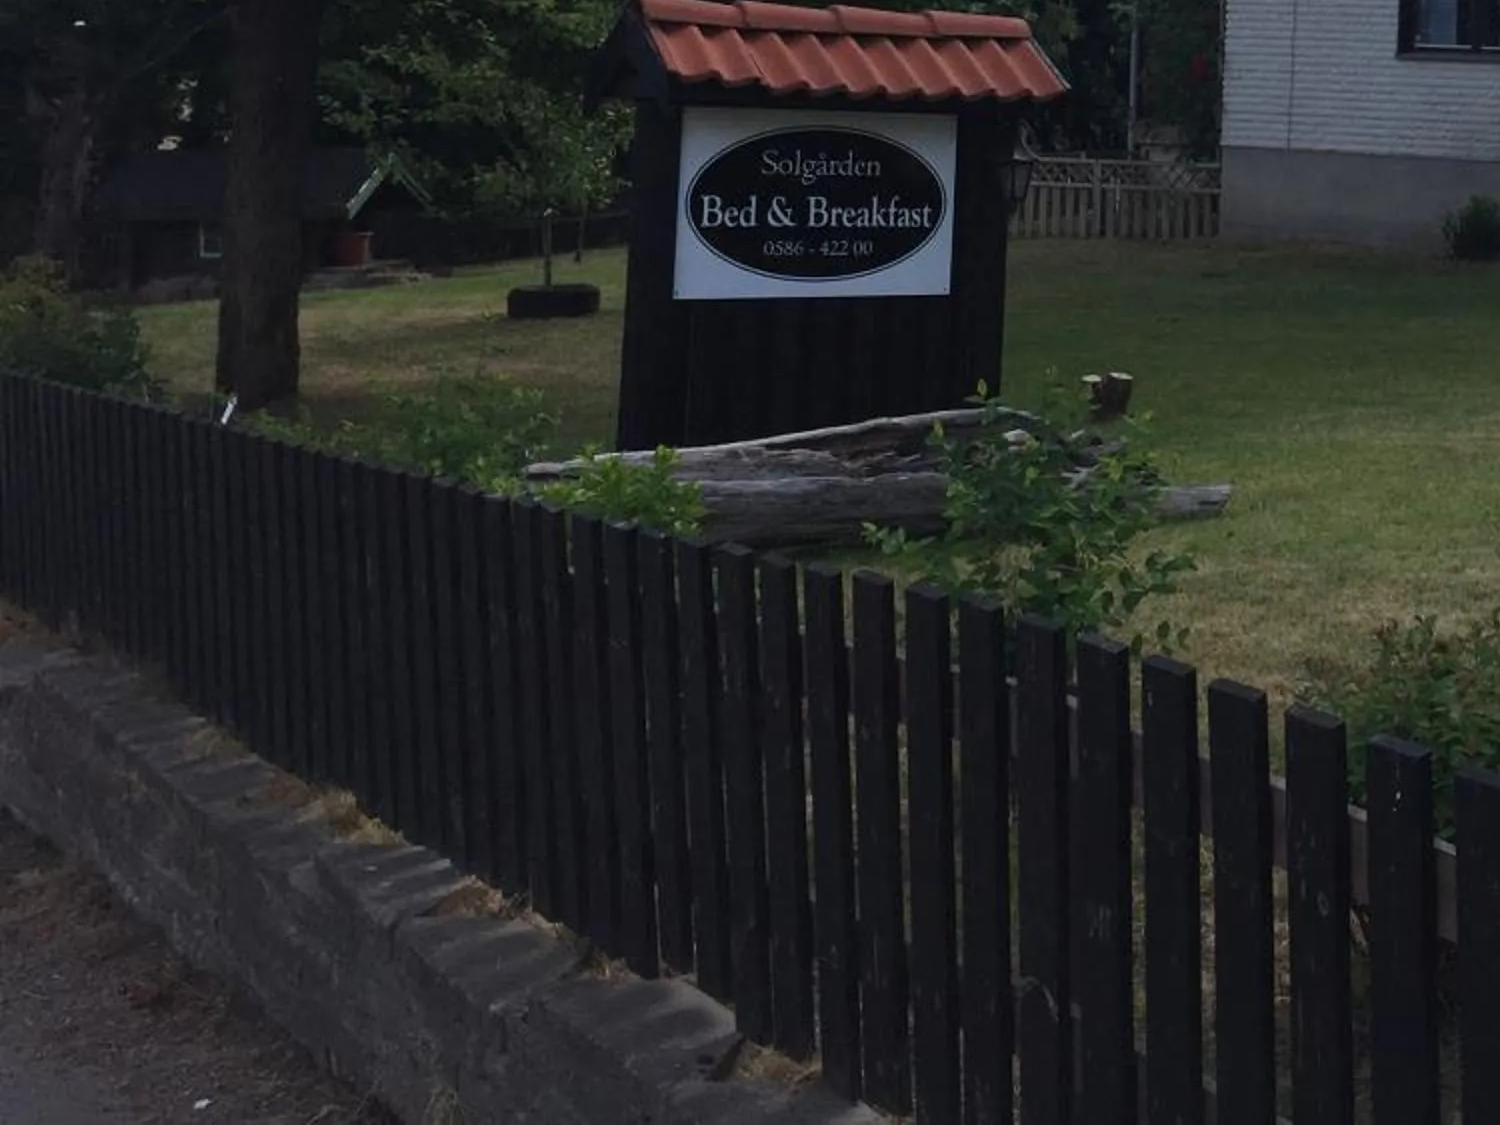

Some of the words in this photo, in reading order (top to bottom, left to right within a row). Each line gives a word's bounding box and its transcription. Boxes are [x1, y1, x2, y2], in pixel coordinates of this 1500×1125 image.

[761, 149, 881, 185] Solgården
[701, 195, 757, 228] Bed
[767, 195, 797, 227] &
[807, 195, 932, 228] Breakfast
[763, 240, 804, 257] 0586
